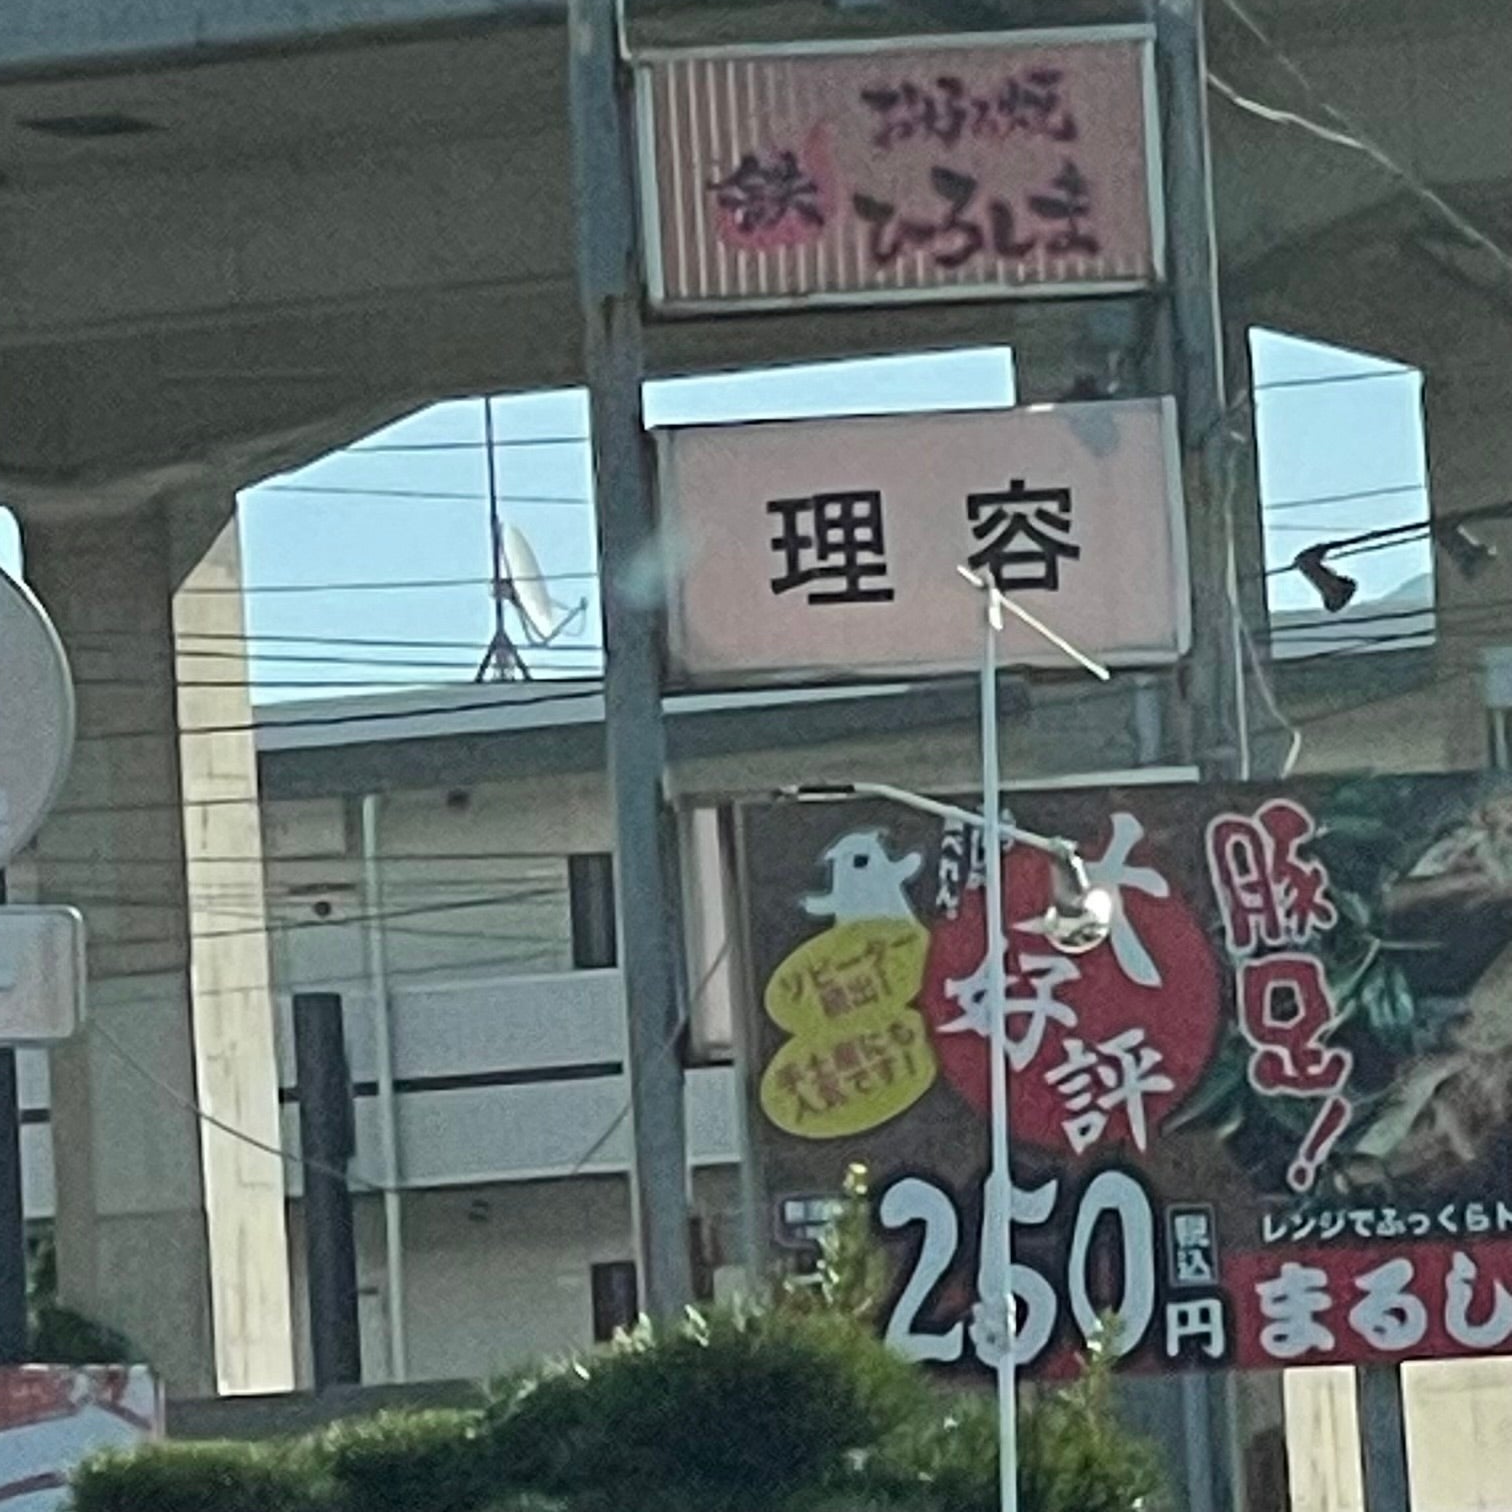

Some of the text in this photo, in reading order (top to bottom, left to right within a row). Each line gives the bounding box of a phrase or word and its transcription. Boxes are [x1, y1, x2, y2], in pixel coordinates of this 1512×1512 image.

[765, 479, 1081, 605] 理容
[879, 1169, 1155, 1368] 250
[1254, 1250, 1512, 1360] まるし
[1165, 1297, 1226, 1360] 円
